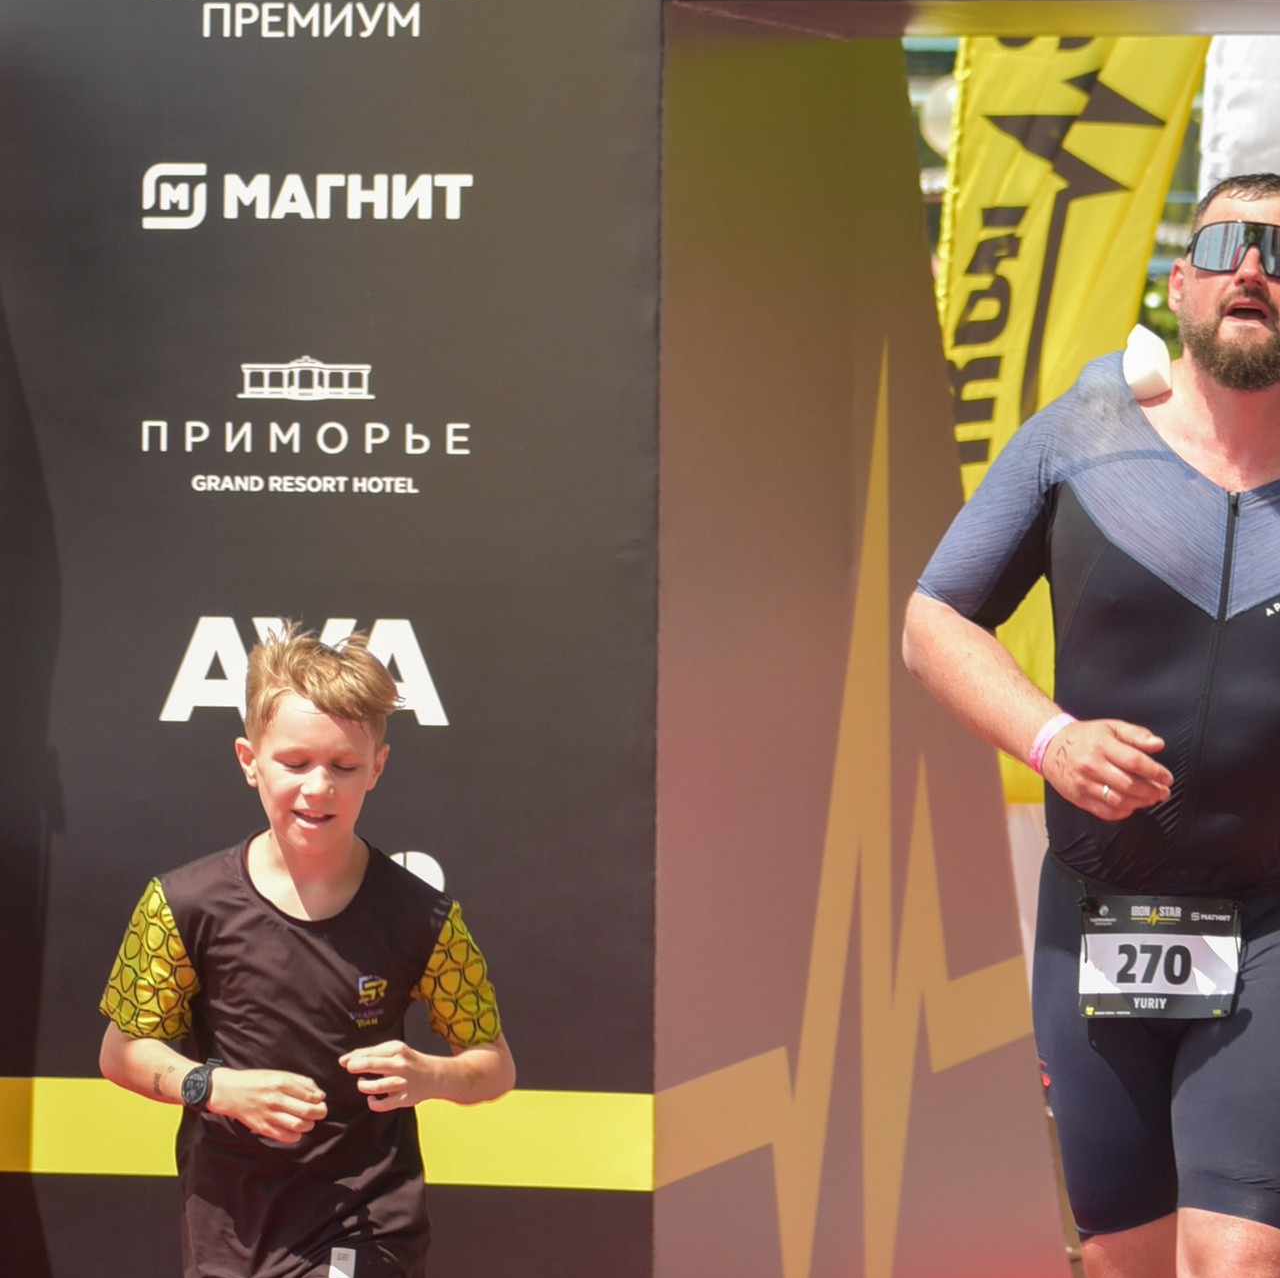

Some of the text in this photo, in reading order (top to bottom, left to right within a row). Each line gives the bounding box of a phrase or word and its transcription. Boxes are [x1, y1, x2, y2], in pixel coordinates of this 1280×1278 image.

[202, 2, 421, 38] ПРЕМИУМ
[223, 173, 474, 220] МАГНИТ
[141, 420, 471, 455] ПРИМОРЬЕ
[191, 474, 420, 494] GRAND RESORT HOTEL
[1158, 906, 1182, 918] STAR
[1115, 943, 1192, 986] 270
[1133, 997, 1168, 1010] YURIY
